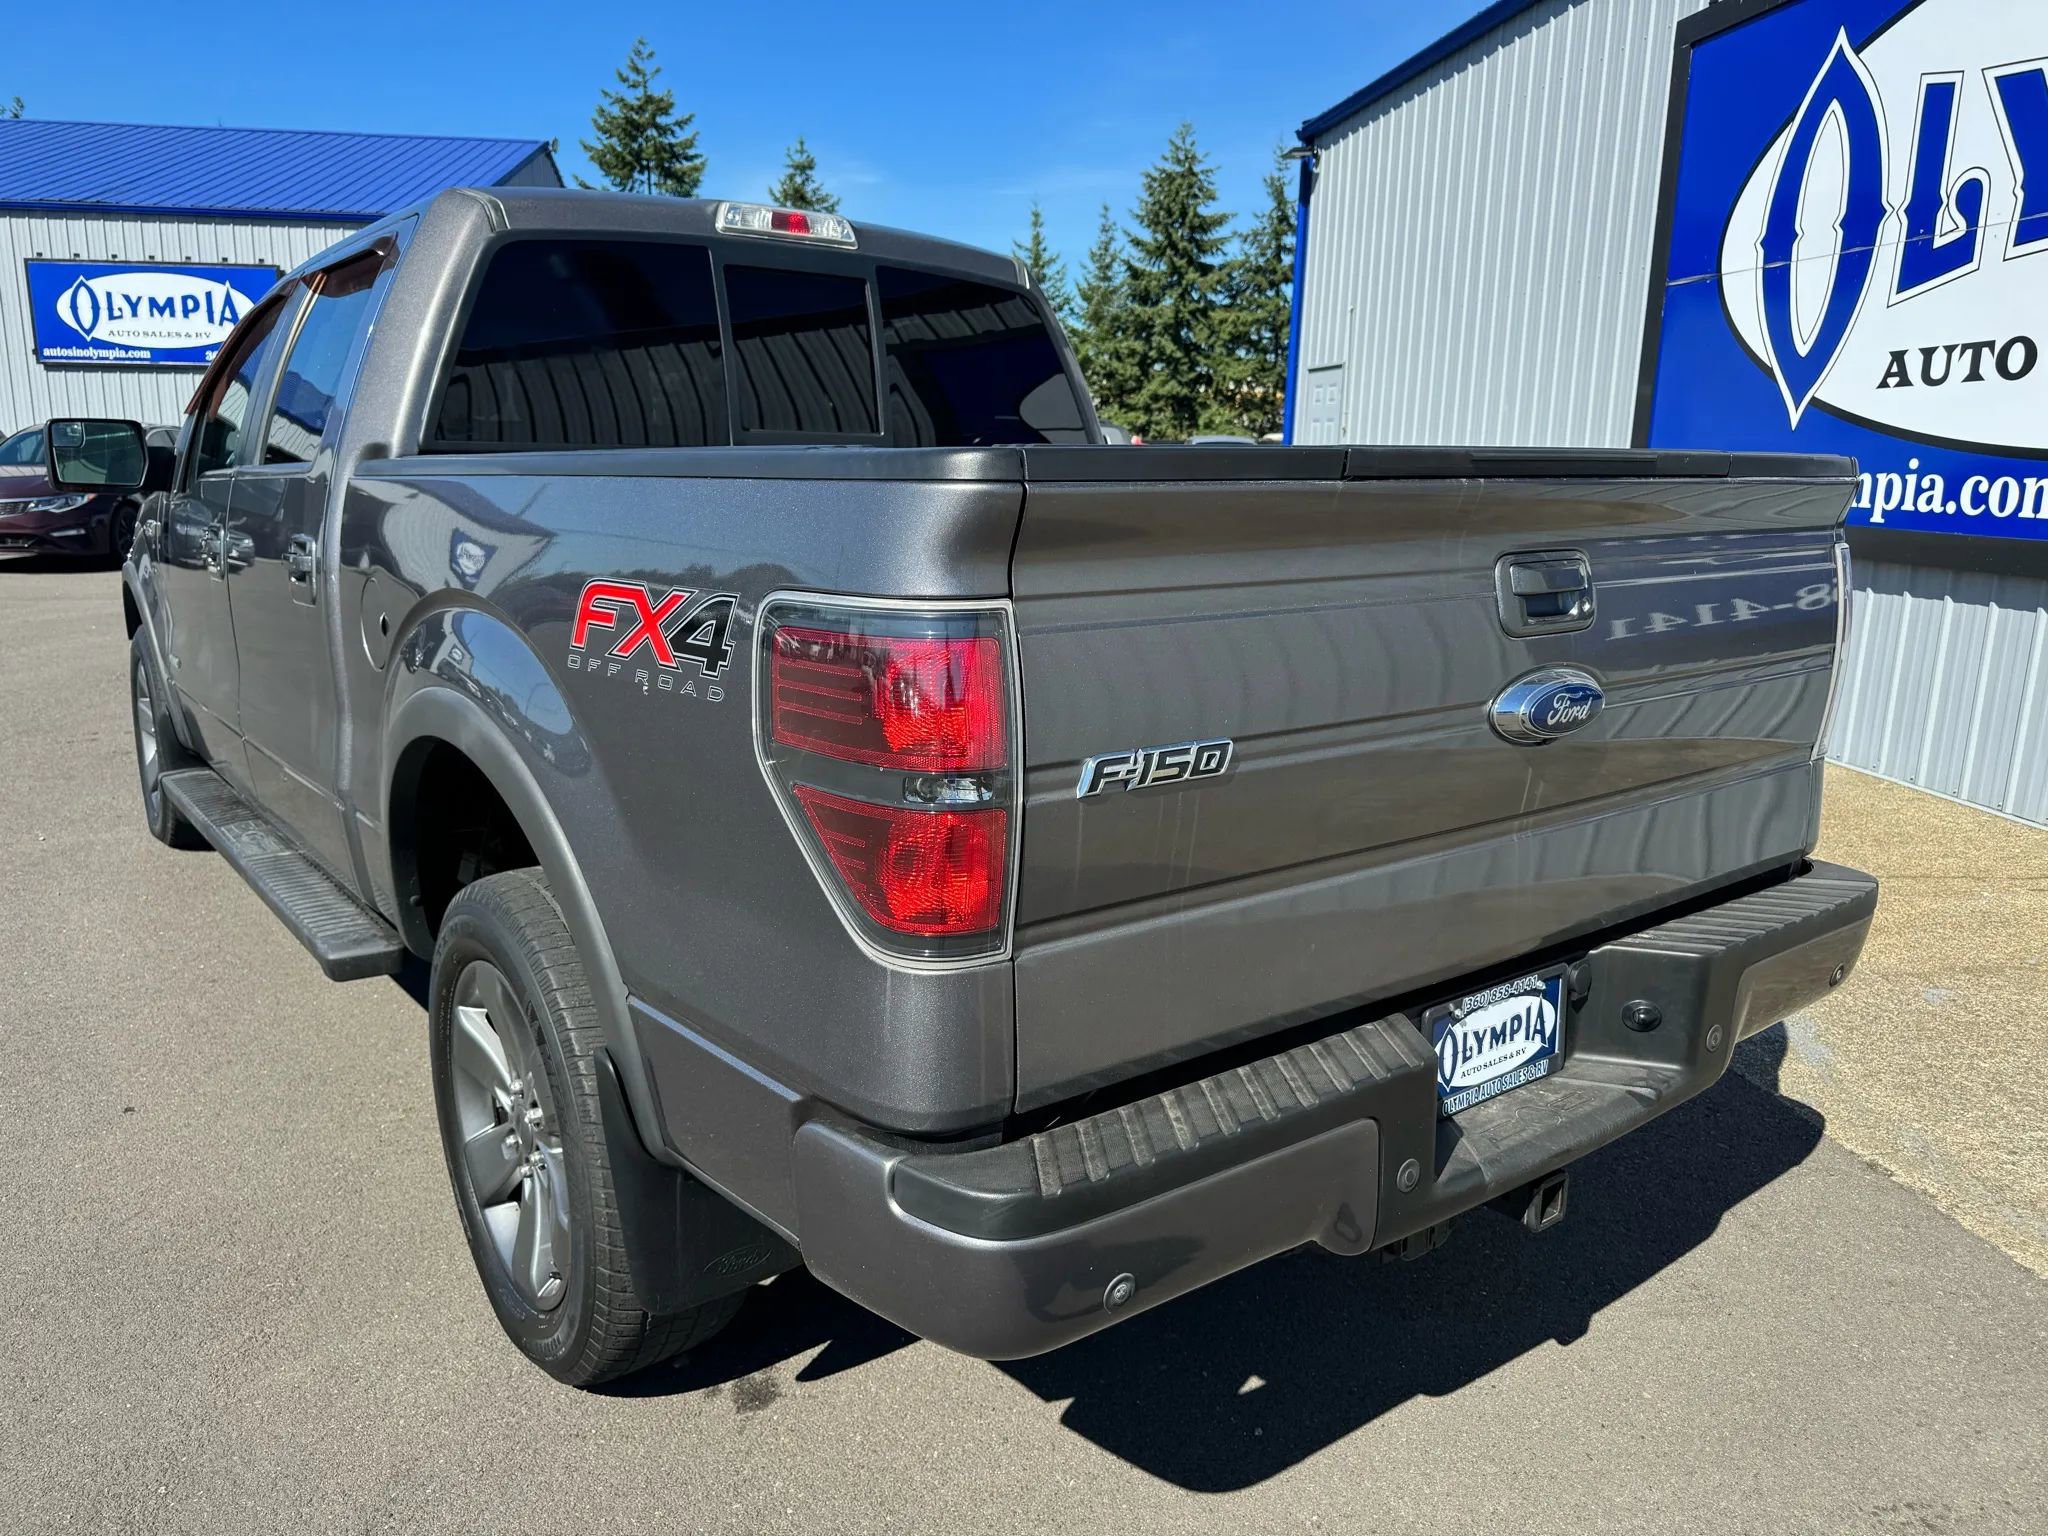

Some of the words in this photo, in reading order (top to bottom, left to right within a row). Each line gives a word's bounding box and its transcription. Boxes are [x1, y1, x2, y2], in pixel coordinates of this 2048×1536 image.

[69, 278, 240, 338] OLYMPIA
[43, 346, 151, 360] autosinolympia.com
[108, 330, 140, 338] AUTO
[142, 331, 183, 339] SALES
[1876, 335, 2038, 389] AUTO
[569, 577, 741, 680] FX4
[567, 654, 621, 677] OFF
[635, 668, 725, 702] ROAD
[1547, 691, 1591, 726] Ford
[1076, 736, 1233, 798] F-150
[1463, 990, 1490, 1015] (360)
[1490, 974, 1538, 1003] 858-4141
[1438, 995, 1548, 1091] OLYMPIA
[1460, 1065, 1482, 1079] AUTO
[1483, 1055, 1508, 1070] SALES
[1516, 1046, 1527, 1057] RV
[1442, 1087, 1479, 1117] OLYMPIA
[1480, 1077, 1502, 1100] AUTO
[1501, 1066, 1528, 1091] SALES
[1527, 1063, 1536, 1081] &
[1535, 1059, 1549, 1078] RV
